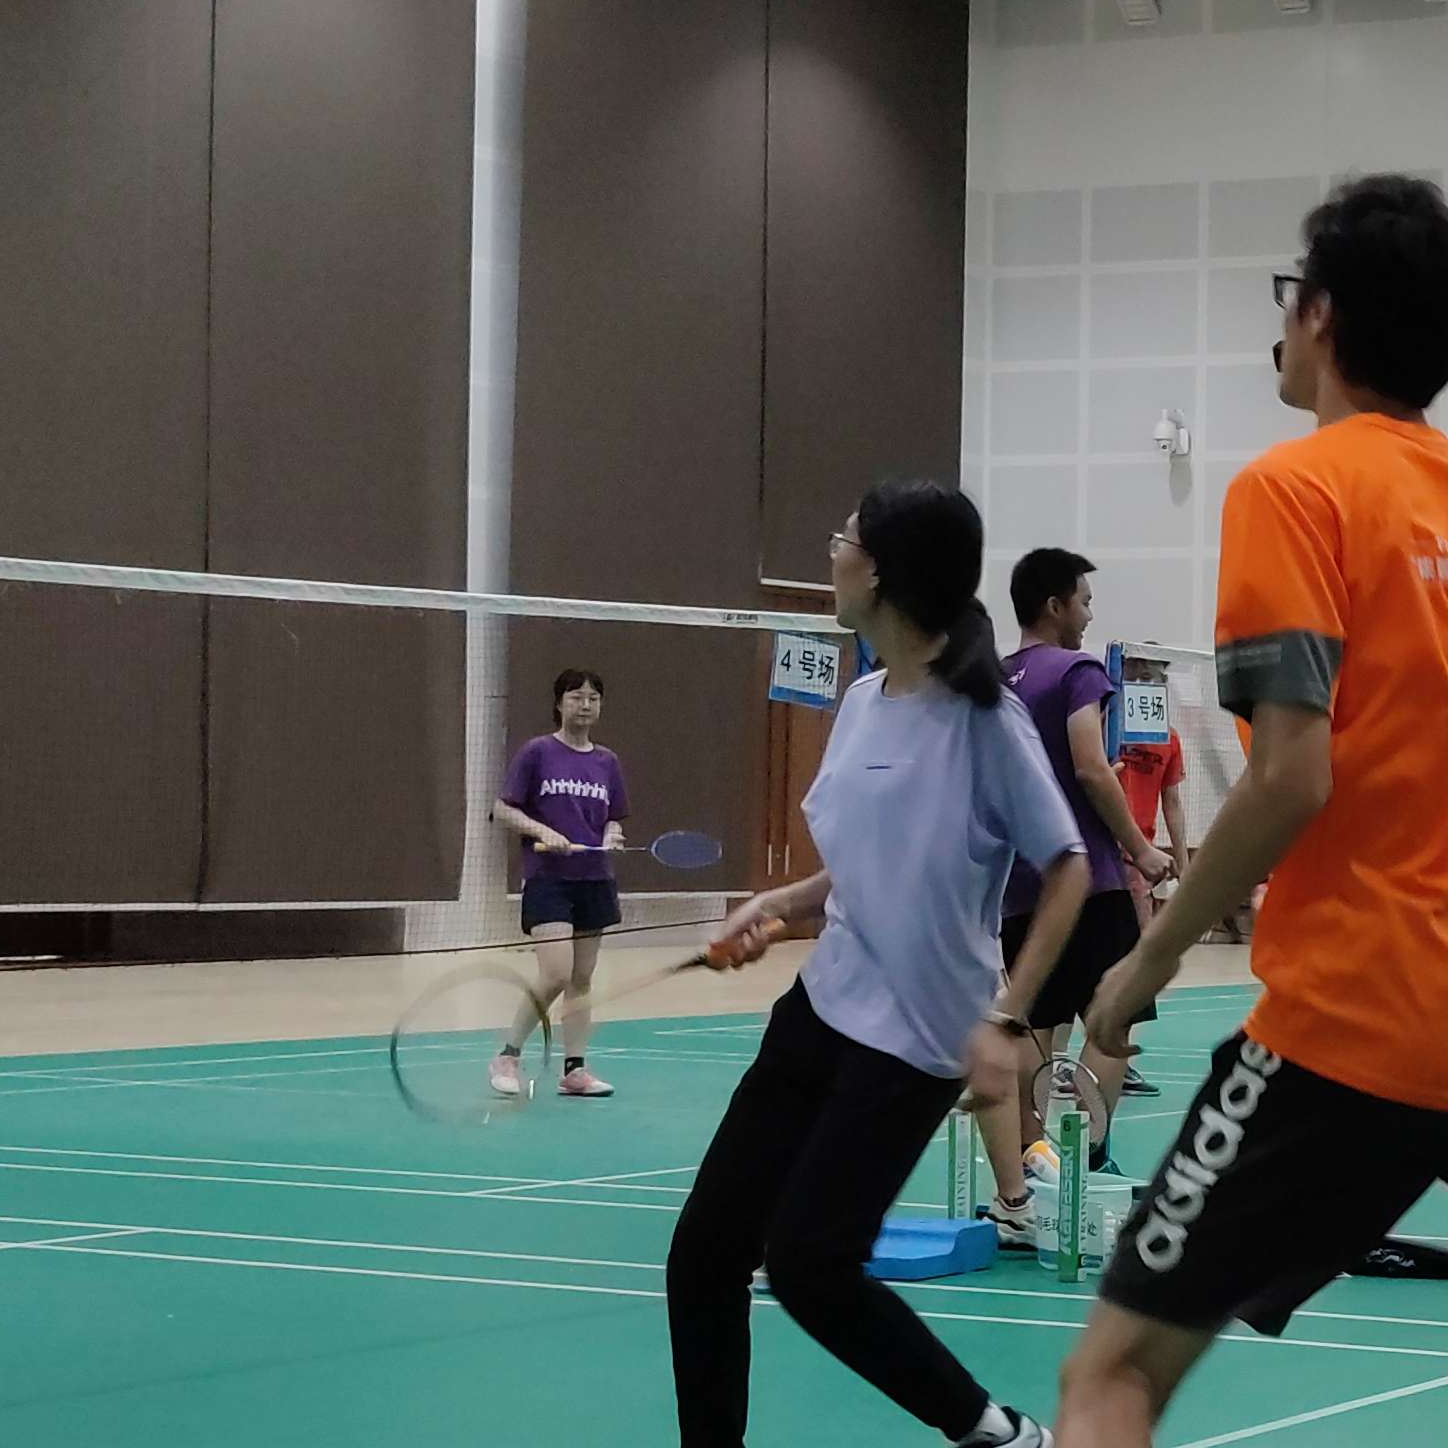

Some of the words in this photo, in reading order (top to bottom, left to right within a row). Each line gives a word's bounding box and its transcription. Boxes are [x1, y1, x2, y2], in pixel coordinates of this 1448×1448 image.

[779, 649, 792, 672] 4
[1127, 697, 1135, 718] 3
[1135, 1039, 1283, 1273] adidas
